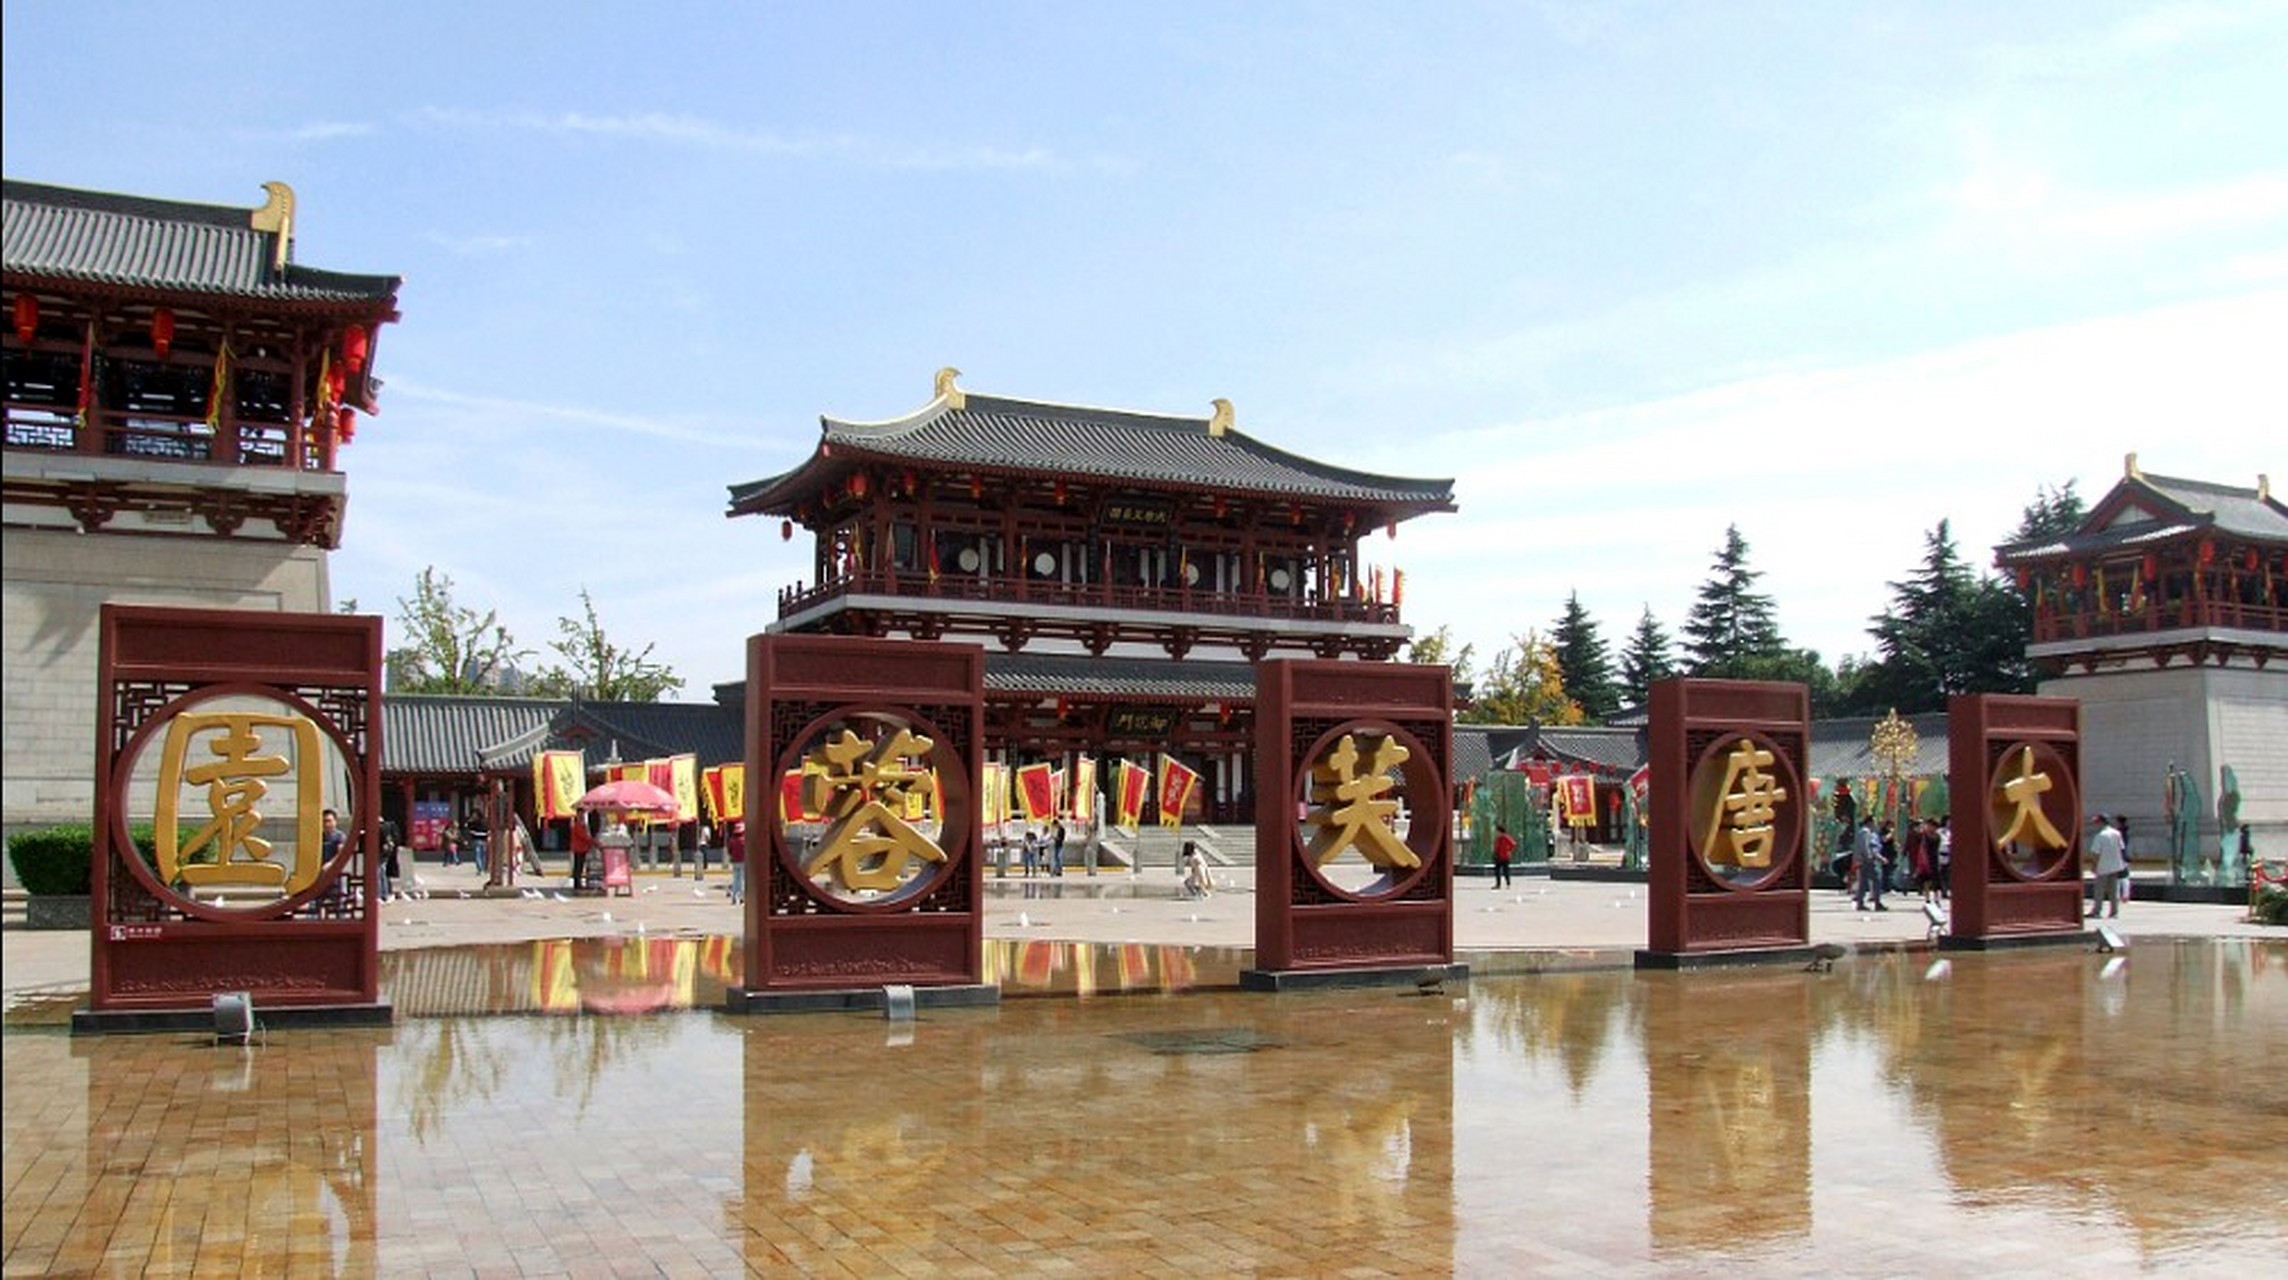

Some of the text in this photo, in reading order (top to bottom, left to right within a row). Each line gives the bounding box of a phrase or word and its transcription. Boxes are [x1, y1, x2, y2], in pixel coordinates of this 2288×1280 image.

[806, 728, 949, 890] 蓉
[1315, 734, 1422, 869] 芙
[1703, 739, 1788, 868] 唐
[1997, 746, 2068, 850] 大
